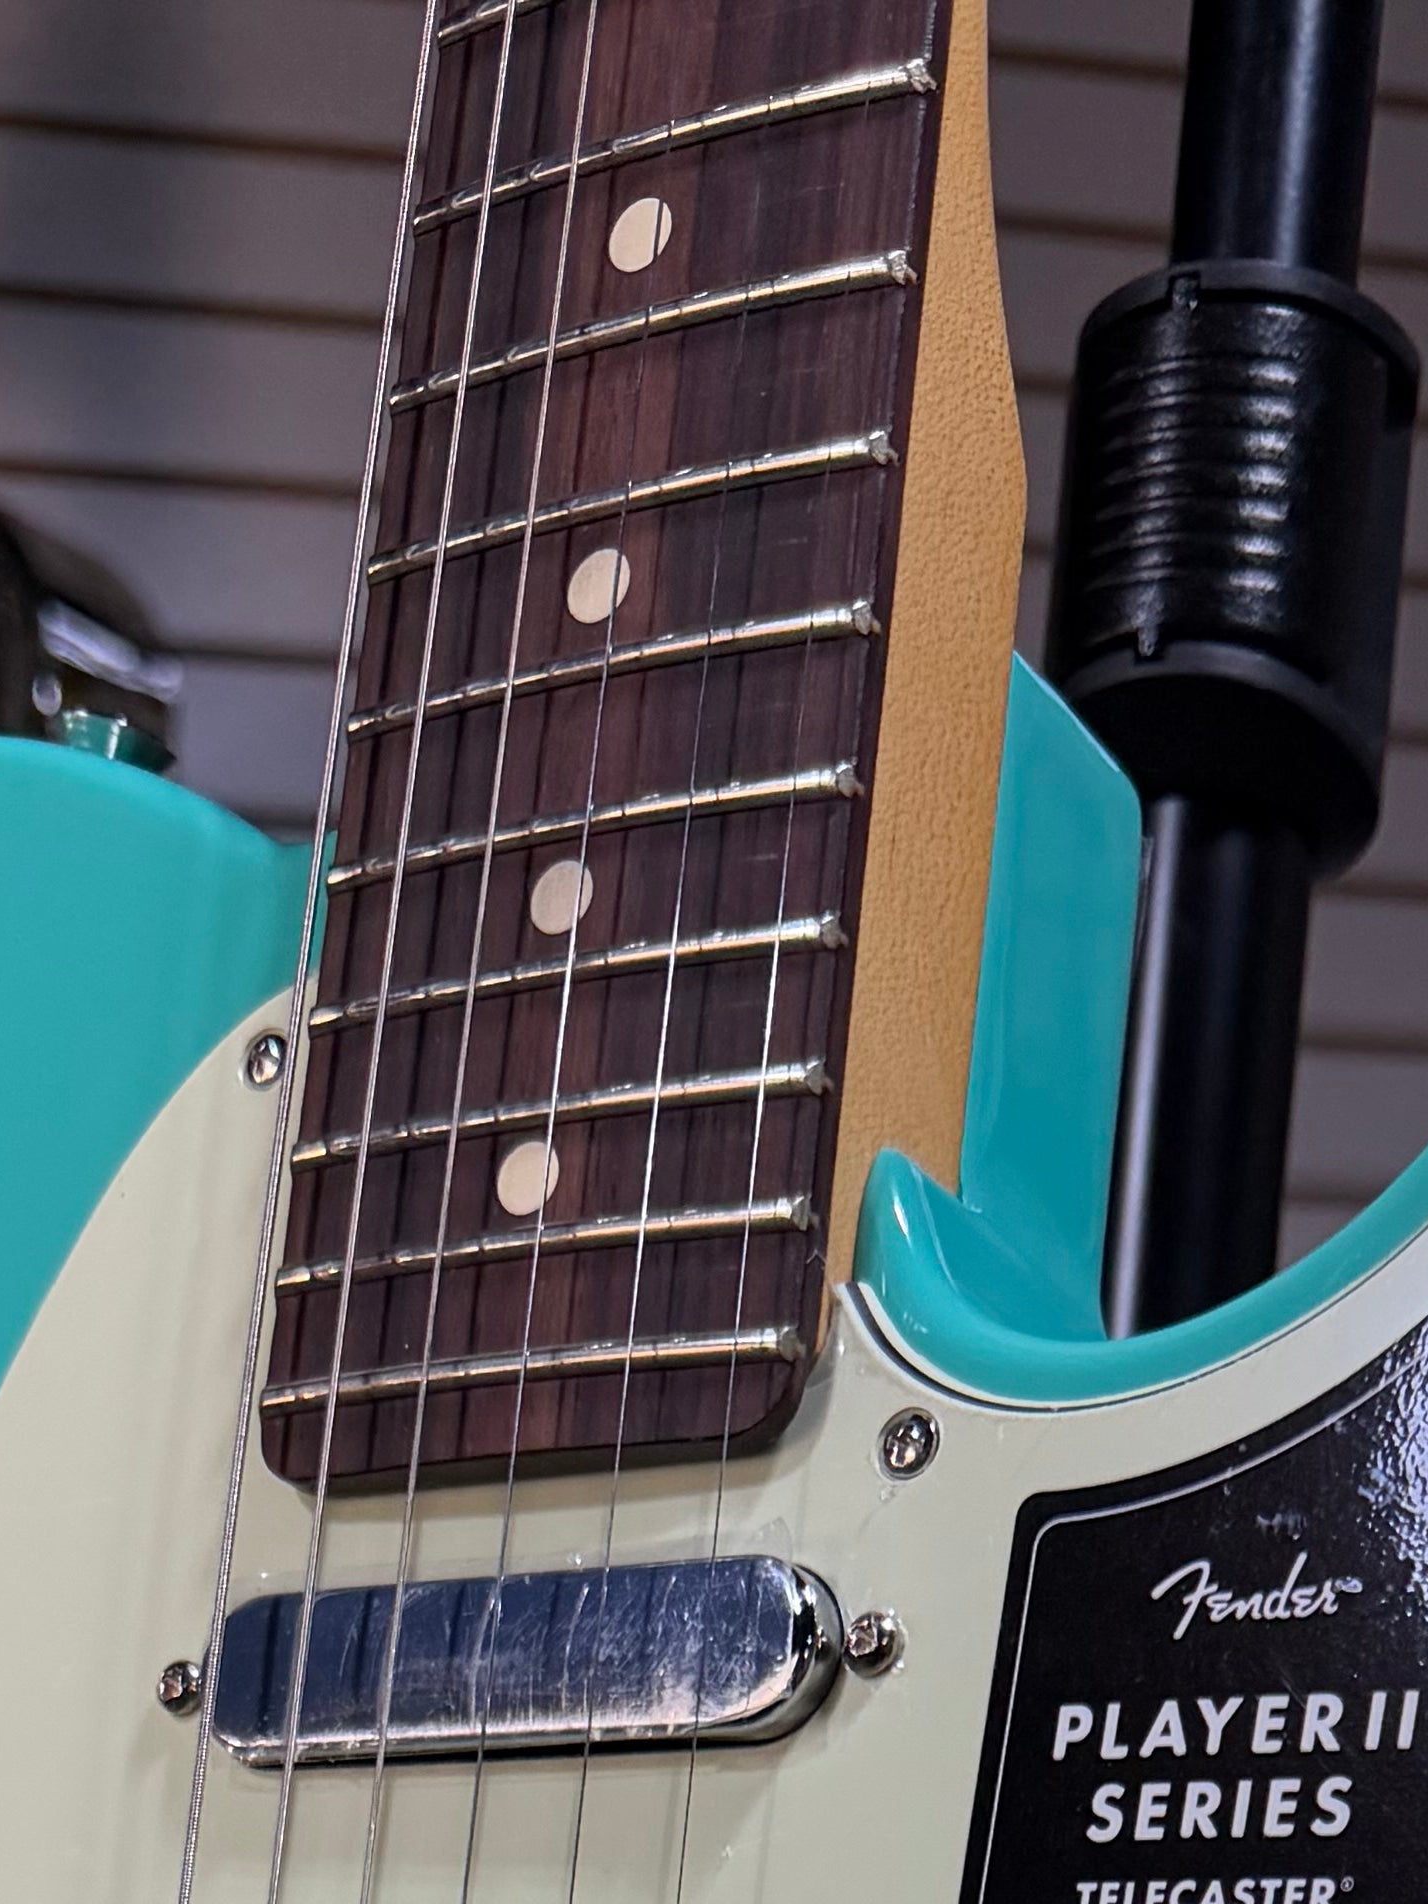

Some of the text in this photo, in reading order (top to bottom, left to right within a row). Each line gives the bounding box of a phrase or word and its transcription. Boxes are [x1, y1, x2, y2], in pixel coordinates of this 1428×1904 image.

[1052, 1689, 1421, 1761] PLAYER II
[1085, 1775, 1353, 1844] SERIES
